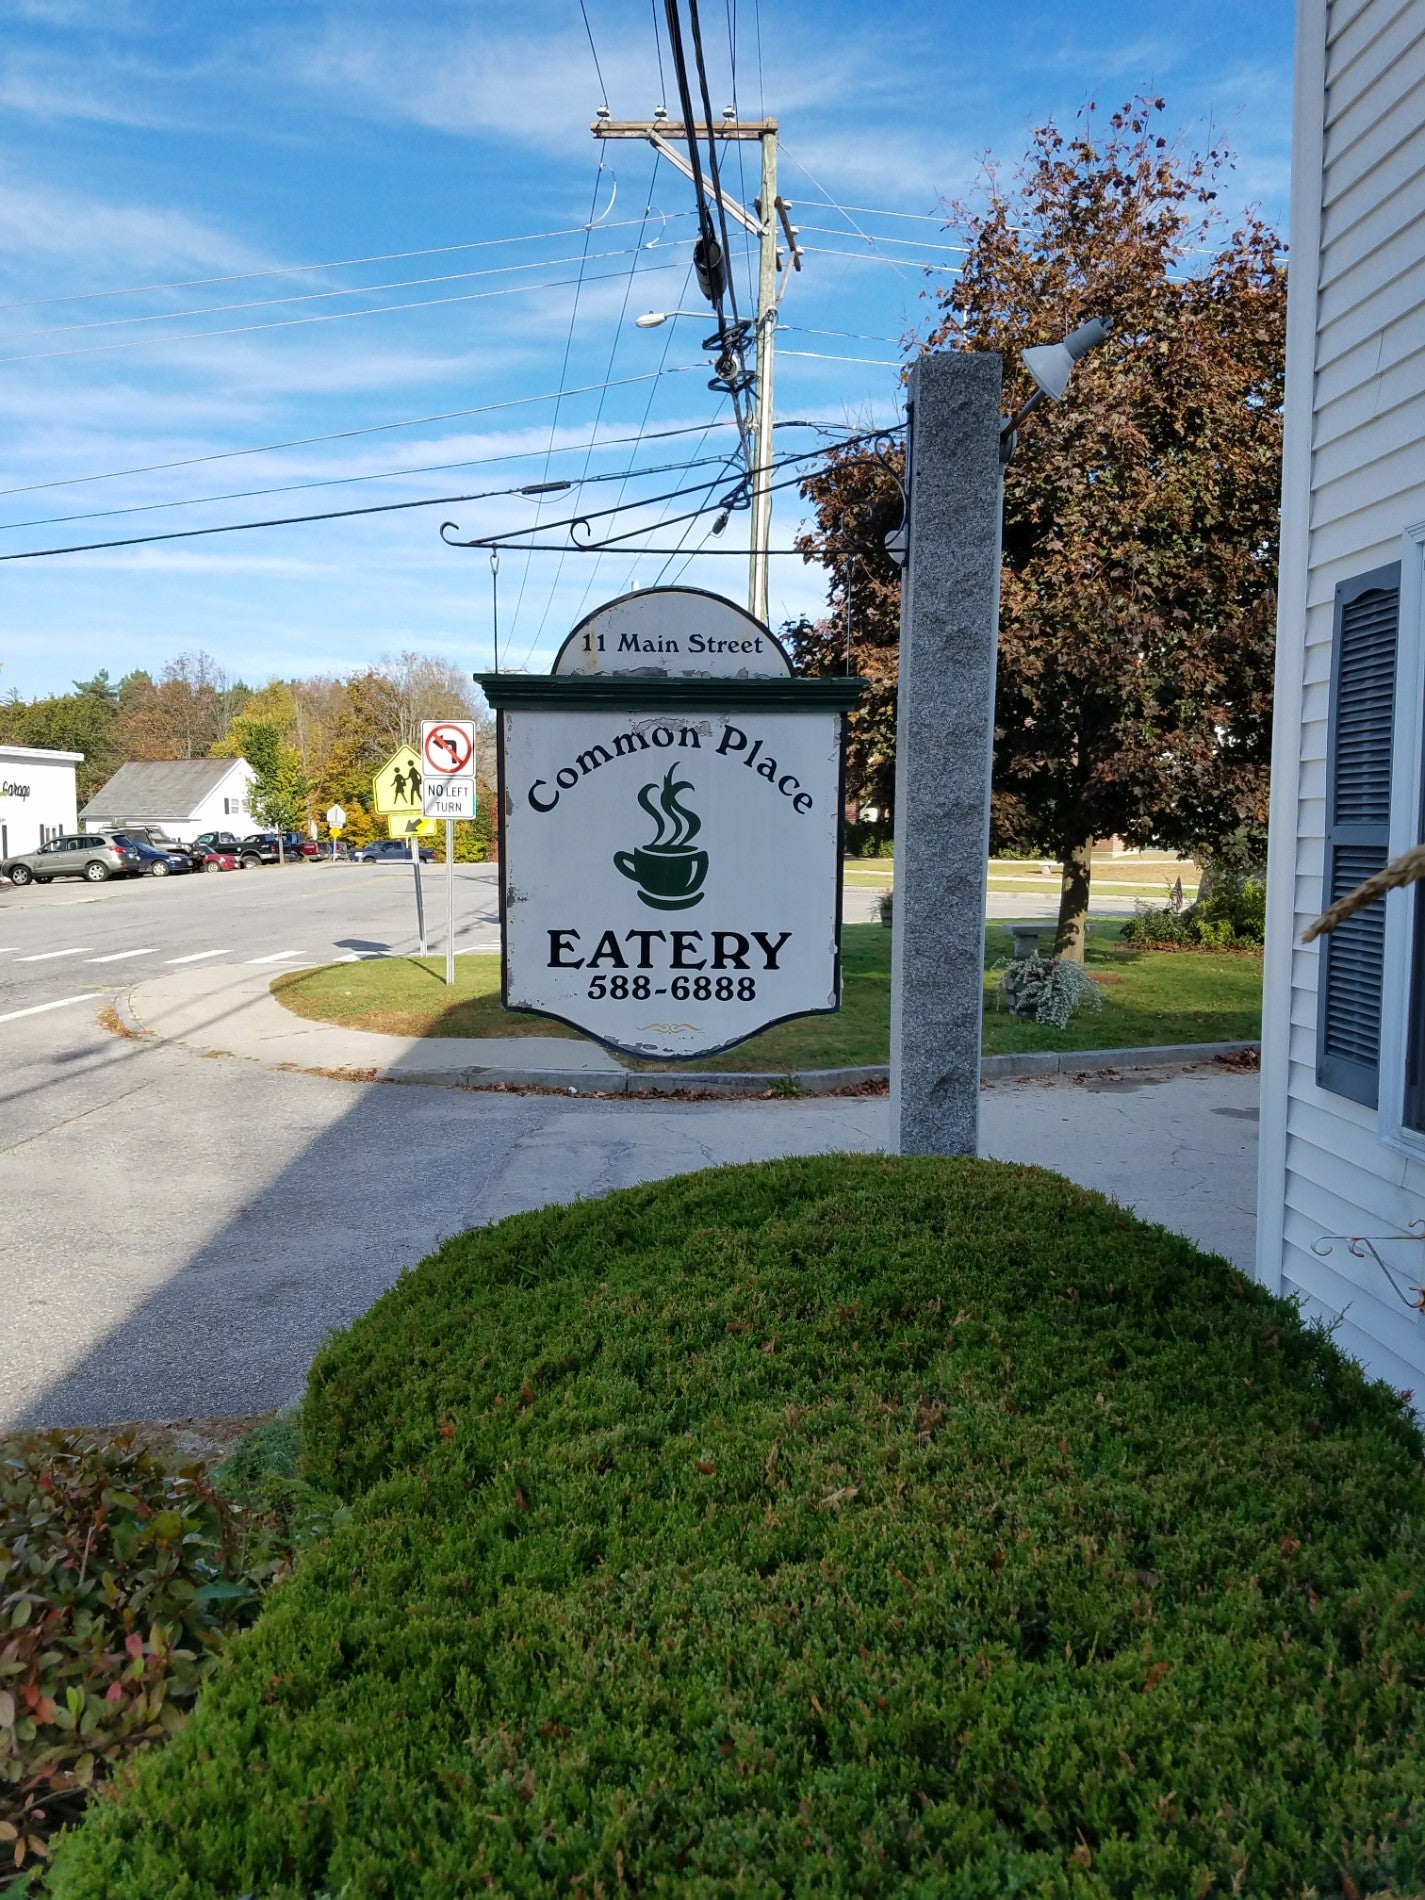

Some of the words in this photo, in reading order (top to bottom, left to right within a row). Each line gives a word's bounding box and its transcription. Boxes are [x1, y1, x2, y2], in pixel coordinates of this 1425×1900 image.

[582, 634, 605, 653] 11
[617, 633, 680, 654] Main
[688, 634, 763, 654] Street
[528, 726, 701, 813] Common
[715, 725, 813, 815] Place
[428, 784, 443, 797] NO
[446, 787, 469, 797] LEFT
[435, 802, 462, 812] TURN
[547, 929, 792, 970] EATERY
[587, 975, 756, 1002] 588-6888
